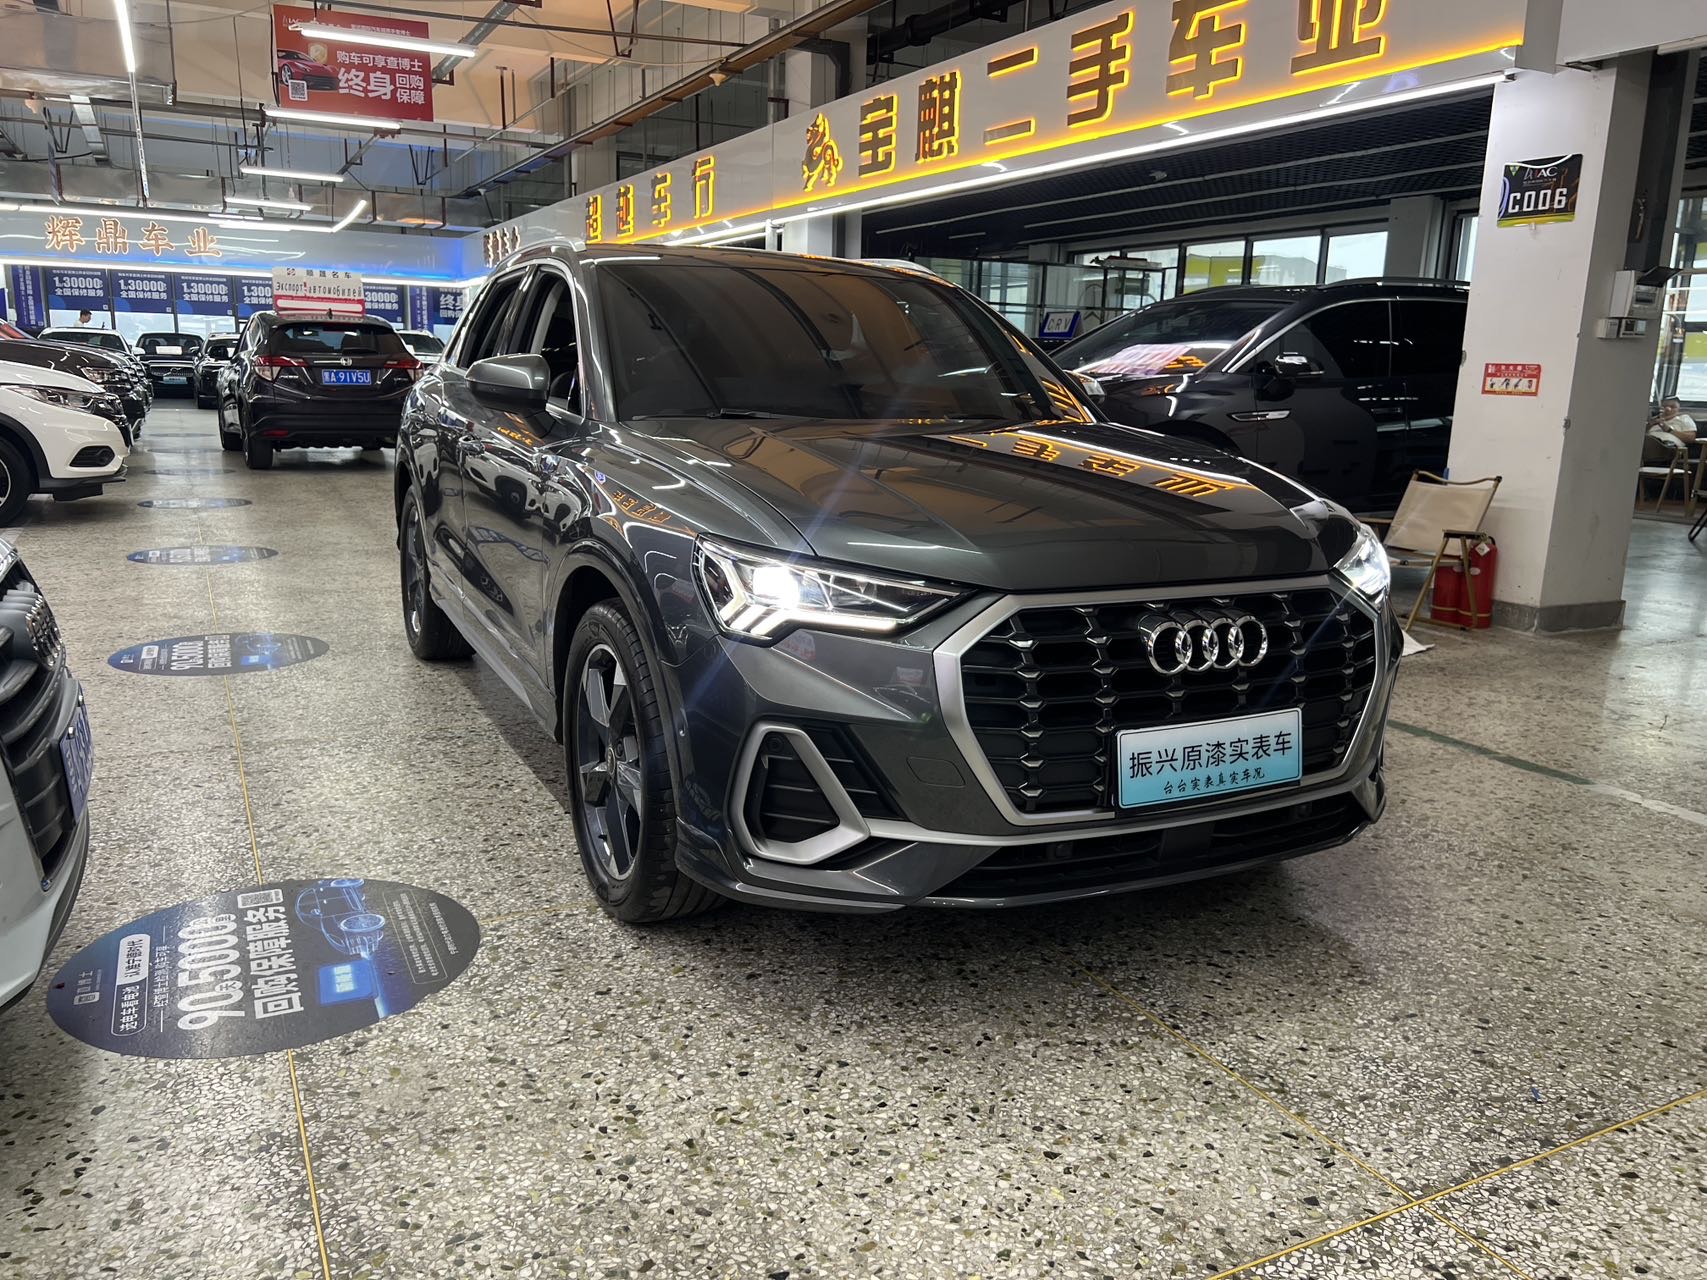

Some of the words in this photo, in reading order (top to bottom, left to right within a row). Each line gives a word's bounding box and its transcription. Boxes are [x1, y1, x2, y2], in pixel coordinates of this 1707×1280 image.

[336, 51, 423, 72] 购车可享查博士
[337, 67, 395, 100] 终身
[396, 73, 424, 90] 回购
[396, 89, 425, 105] 保障
[1508, 187, 1568, 213] C006
[44, 215, 222, 257] 辉鼎车业
[1129, 730, 1293, 779] 振兴原漆实表车
[1163, 766, 1266, 795] 台台实表真实车况
[244, 905, 302, 1019] 回购保障服务
